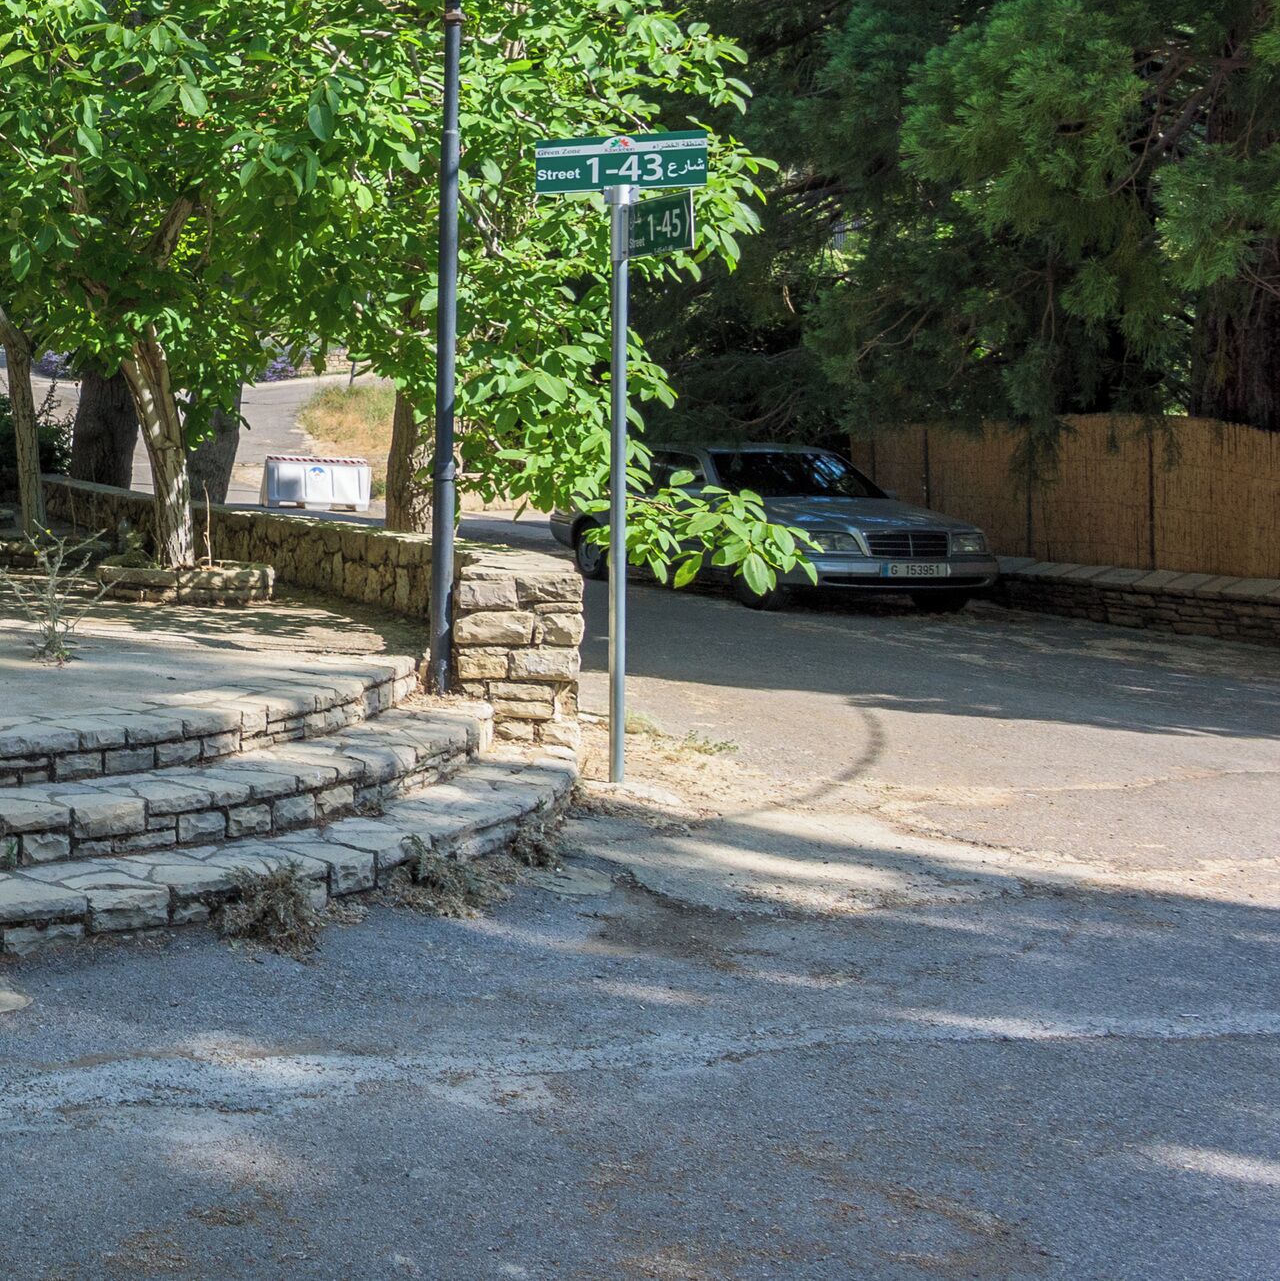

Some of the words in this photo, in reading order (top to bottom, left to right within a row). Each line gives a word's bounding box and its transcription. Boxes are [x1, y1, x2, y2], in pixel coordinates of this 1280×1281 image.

[538, 148, 560, 156] Green
[561, 147, 582, 155] Zone
[537, 168, 581, 181] Street
[586, 153, 664, 184] 1-43
[667, 158, 705, 177] شارع
[647, 208, 682, 242] 1-45
[891, 564, 898, 575] G
[906, 564, 940, 575] 153951
